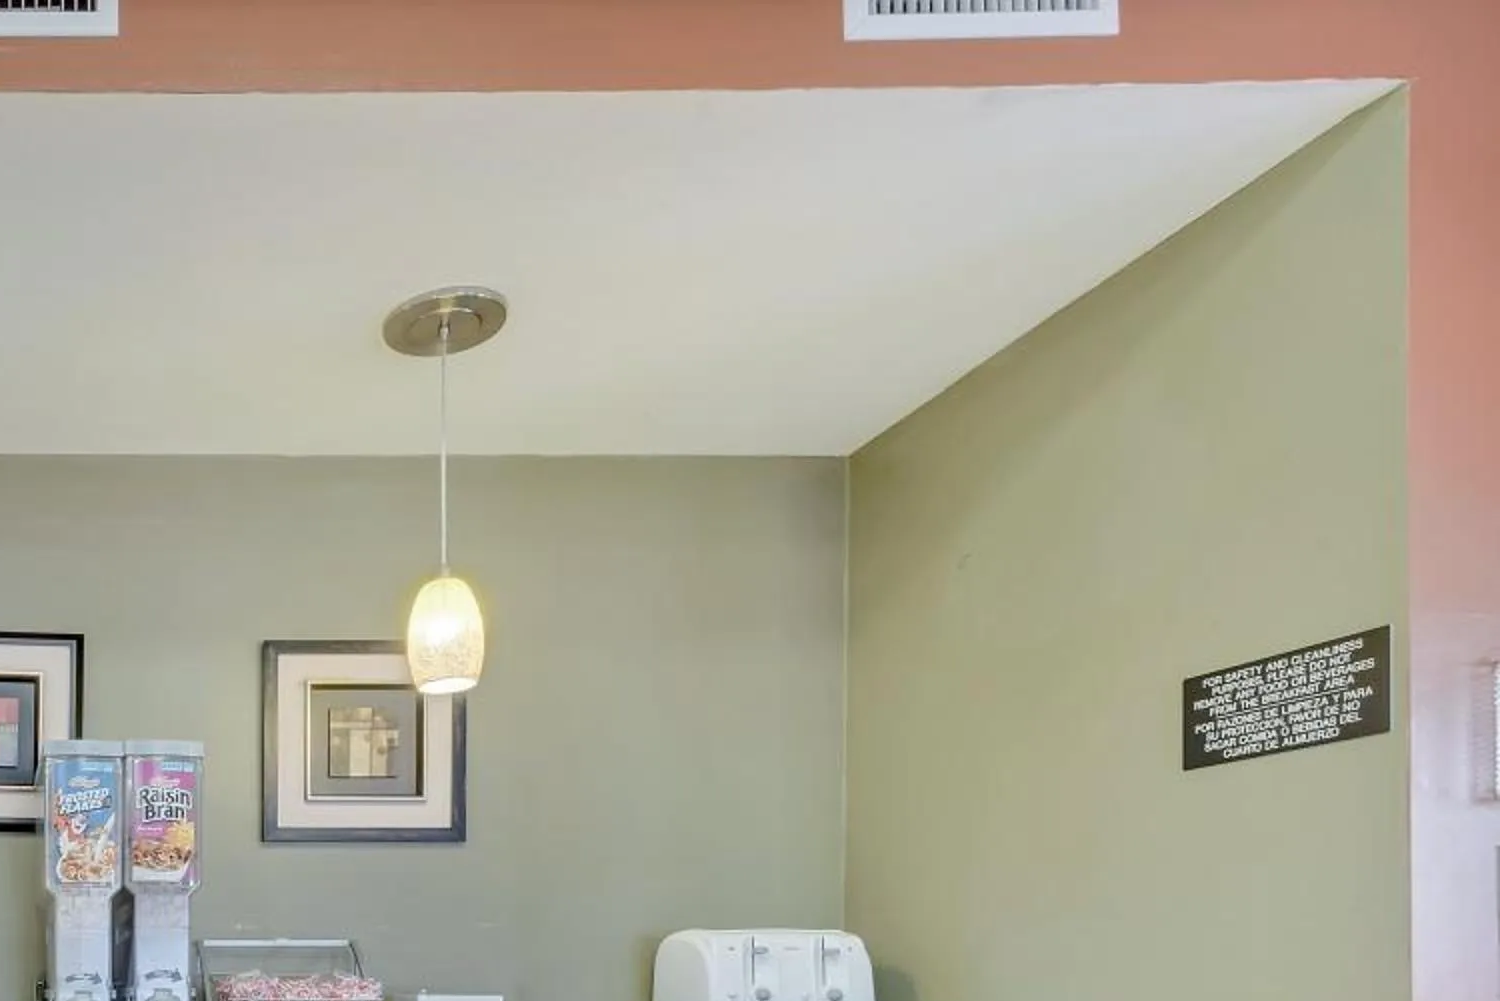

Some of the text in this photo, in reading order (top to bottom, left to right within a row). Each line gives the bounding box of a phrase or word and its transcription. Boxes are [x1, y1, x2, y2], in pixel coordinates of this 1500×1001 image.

[1203, 638, 1362, 688] FOR SAFETY AND CLEANLINESS
[1267, 664, 1305, 681] PLEASE
[1329, 652, 1352, 666] NOT
[1259, 679, 1287, 694] FOOD
[1310, 658, 1374, 681] BEVERAGES
[1209, 674, 1353, 716] FROM THE BREAKFAST AREA
[1343, 686, 1372, 700] PARA
[1340, 711, 1362, 724] DEL
[138, 786, 191, 808] Raisin
[144, 804, 186, 820] Bran
